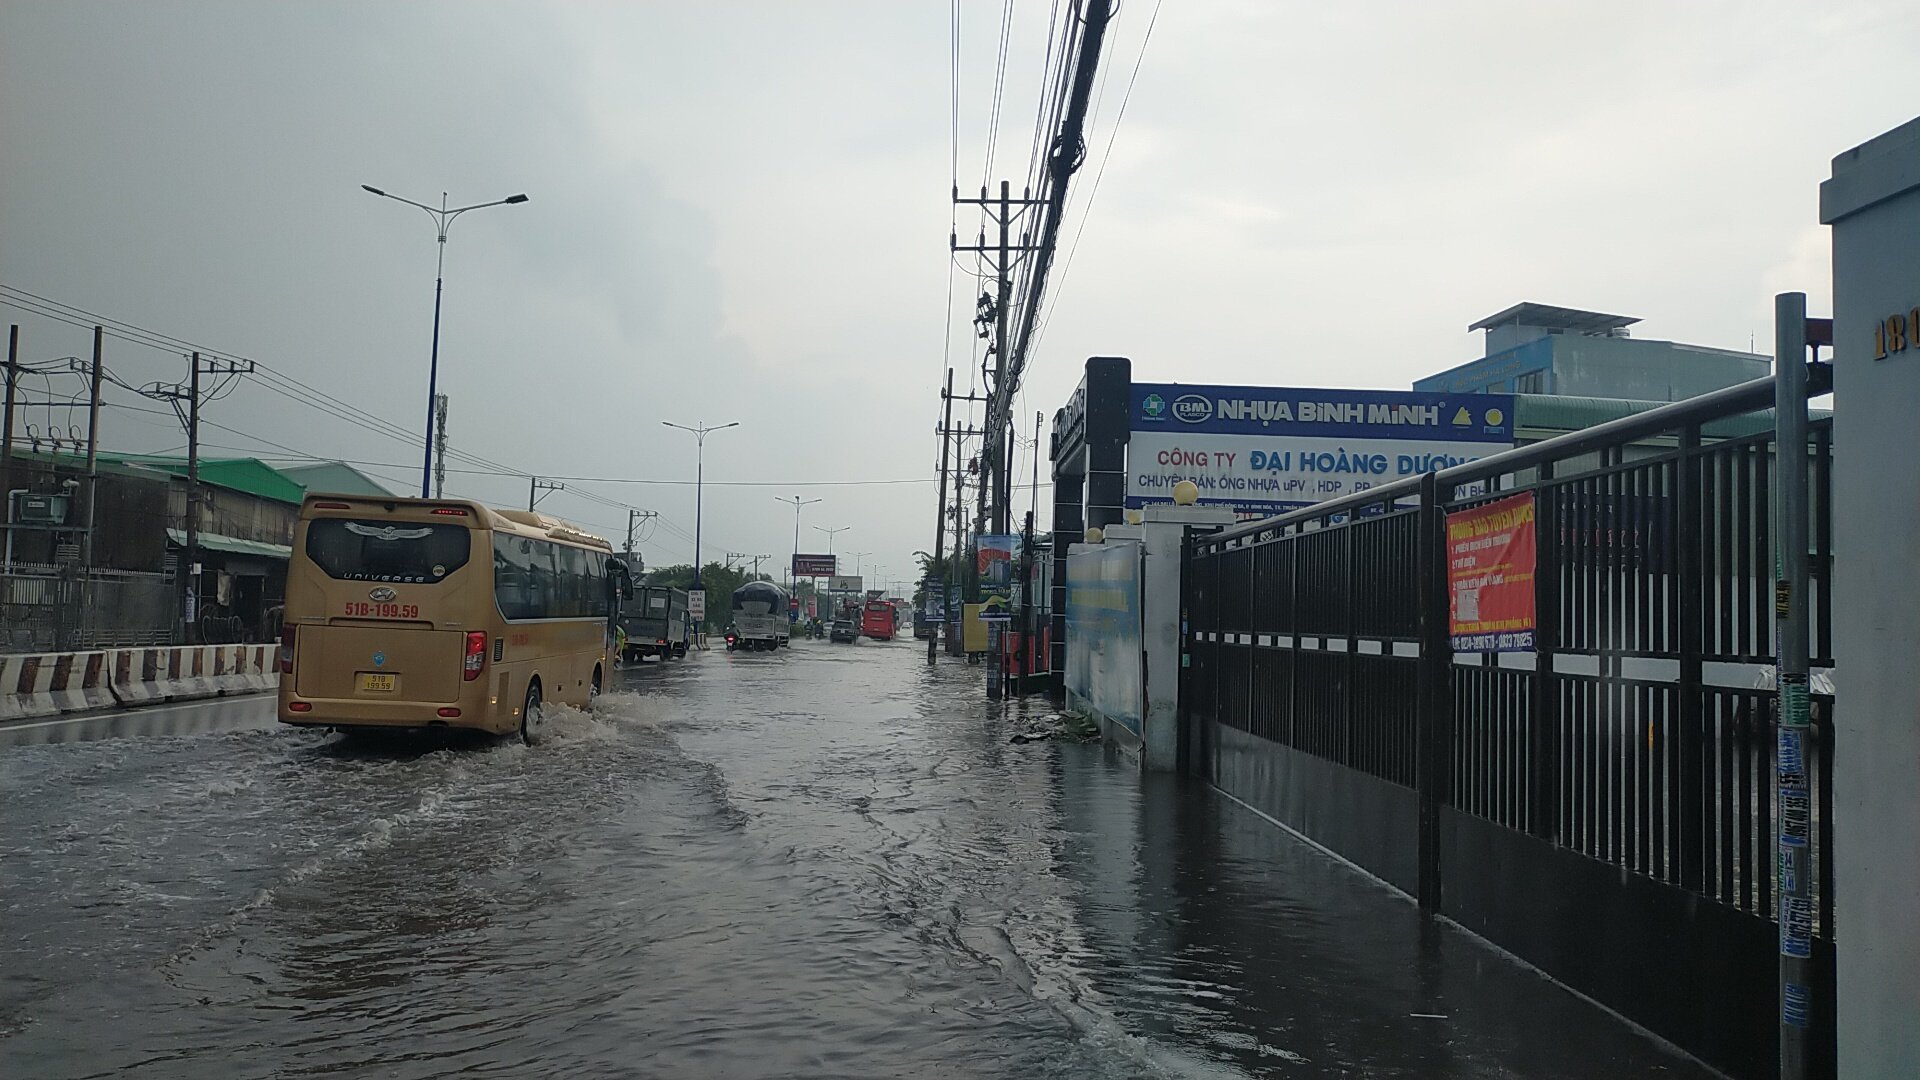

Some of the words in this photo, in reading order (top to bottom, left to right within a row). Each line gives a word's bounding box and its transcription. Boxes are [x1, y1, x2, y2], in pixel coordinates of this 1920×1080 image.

[1217, 399, 1294, 427] NHỰA
[1298, 401, 1364, 424] BÌNH
[1157, 447, 1208, 467] CÔNG
[1214, 452, 1237, 467] TY
[1249, 450, 1291, 476] ĐẠI
[1299, 446, 1388, 475] HOÀNG
[1397, 452, 1480, 475] DƯƠN
[1247, 478, 1280, 493] NHỰA
[343, 573, 425, 583] UNIVERSE
[345, 602, 419, 618] 51B-199.59
